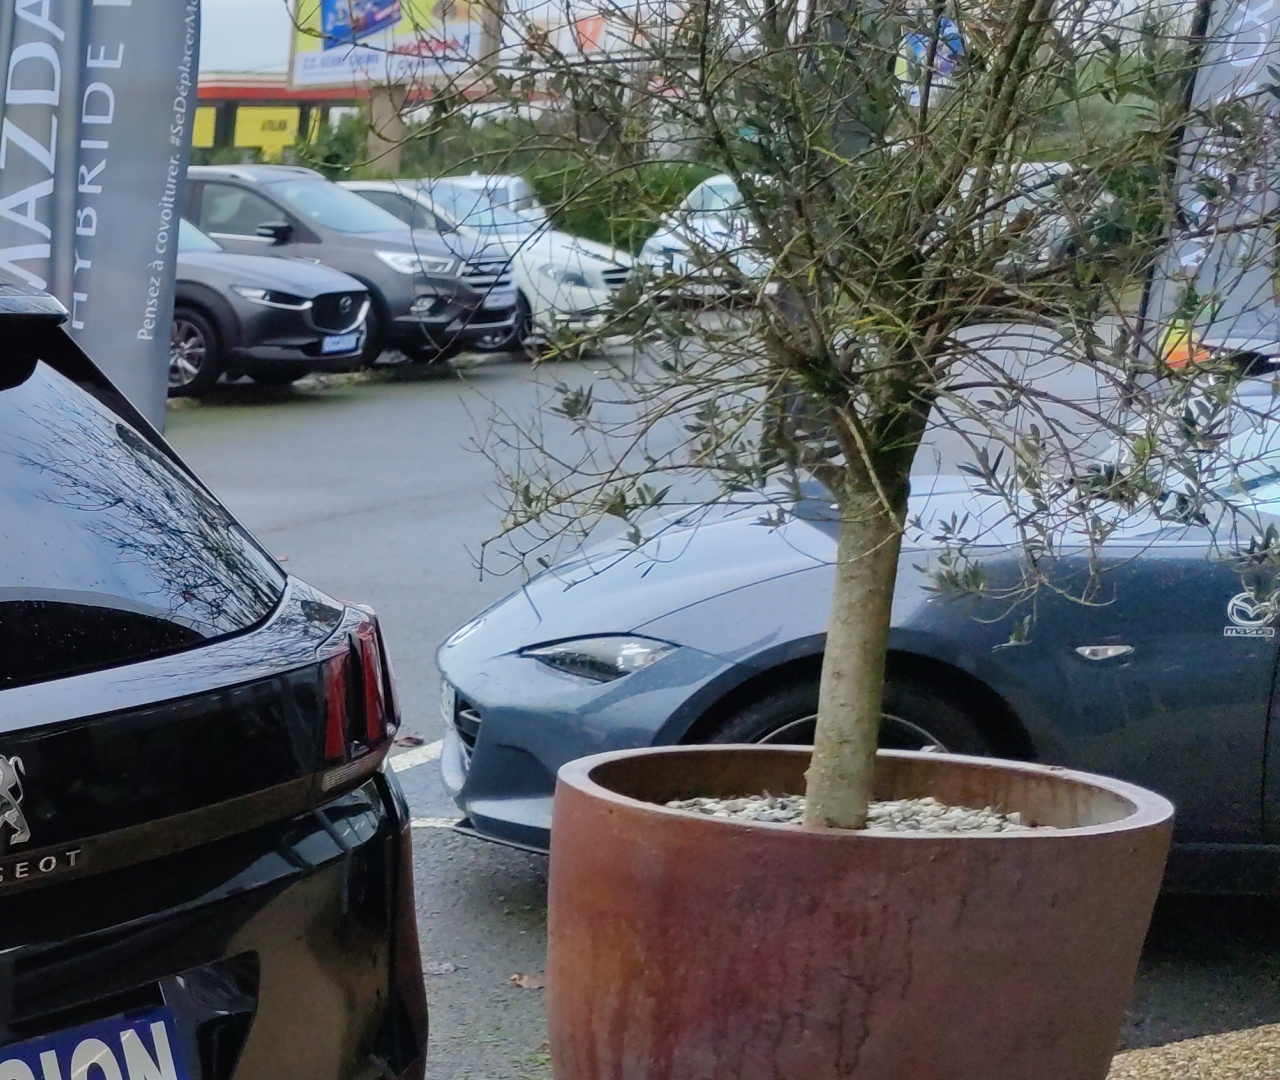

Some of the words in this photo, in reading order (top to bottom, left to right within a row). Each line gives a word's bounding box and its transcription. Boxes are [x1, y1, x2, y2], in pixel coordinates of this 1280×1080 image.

[155, 153, 181, 254] covoiturer.
[147, 259, 165, 271] à
[136, 275, 161, 340] Pensez
